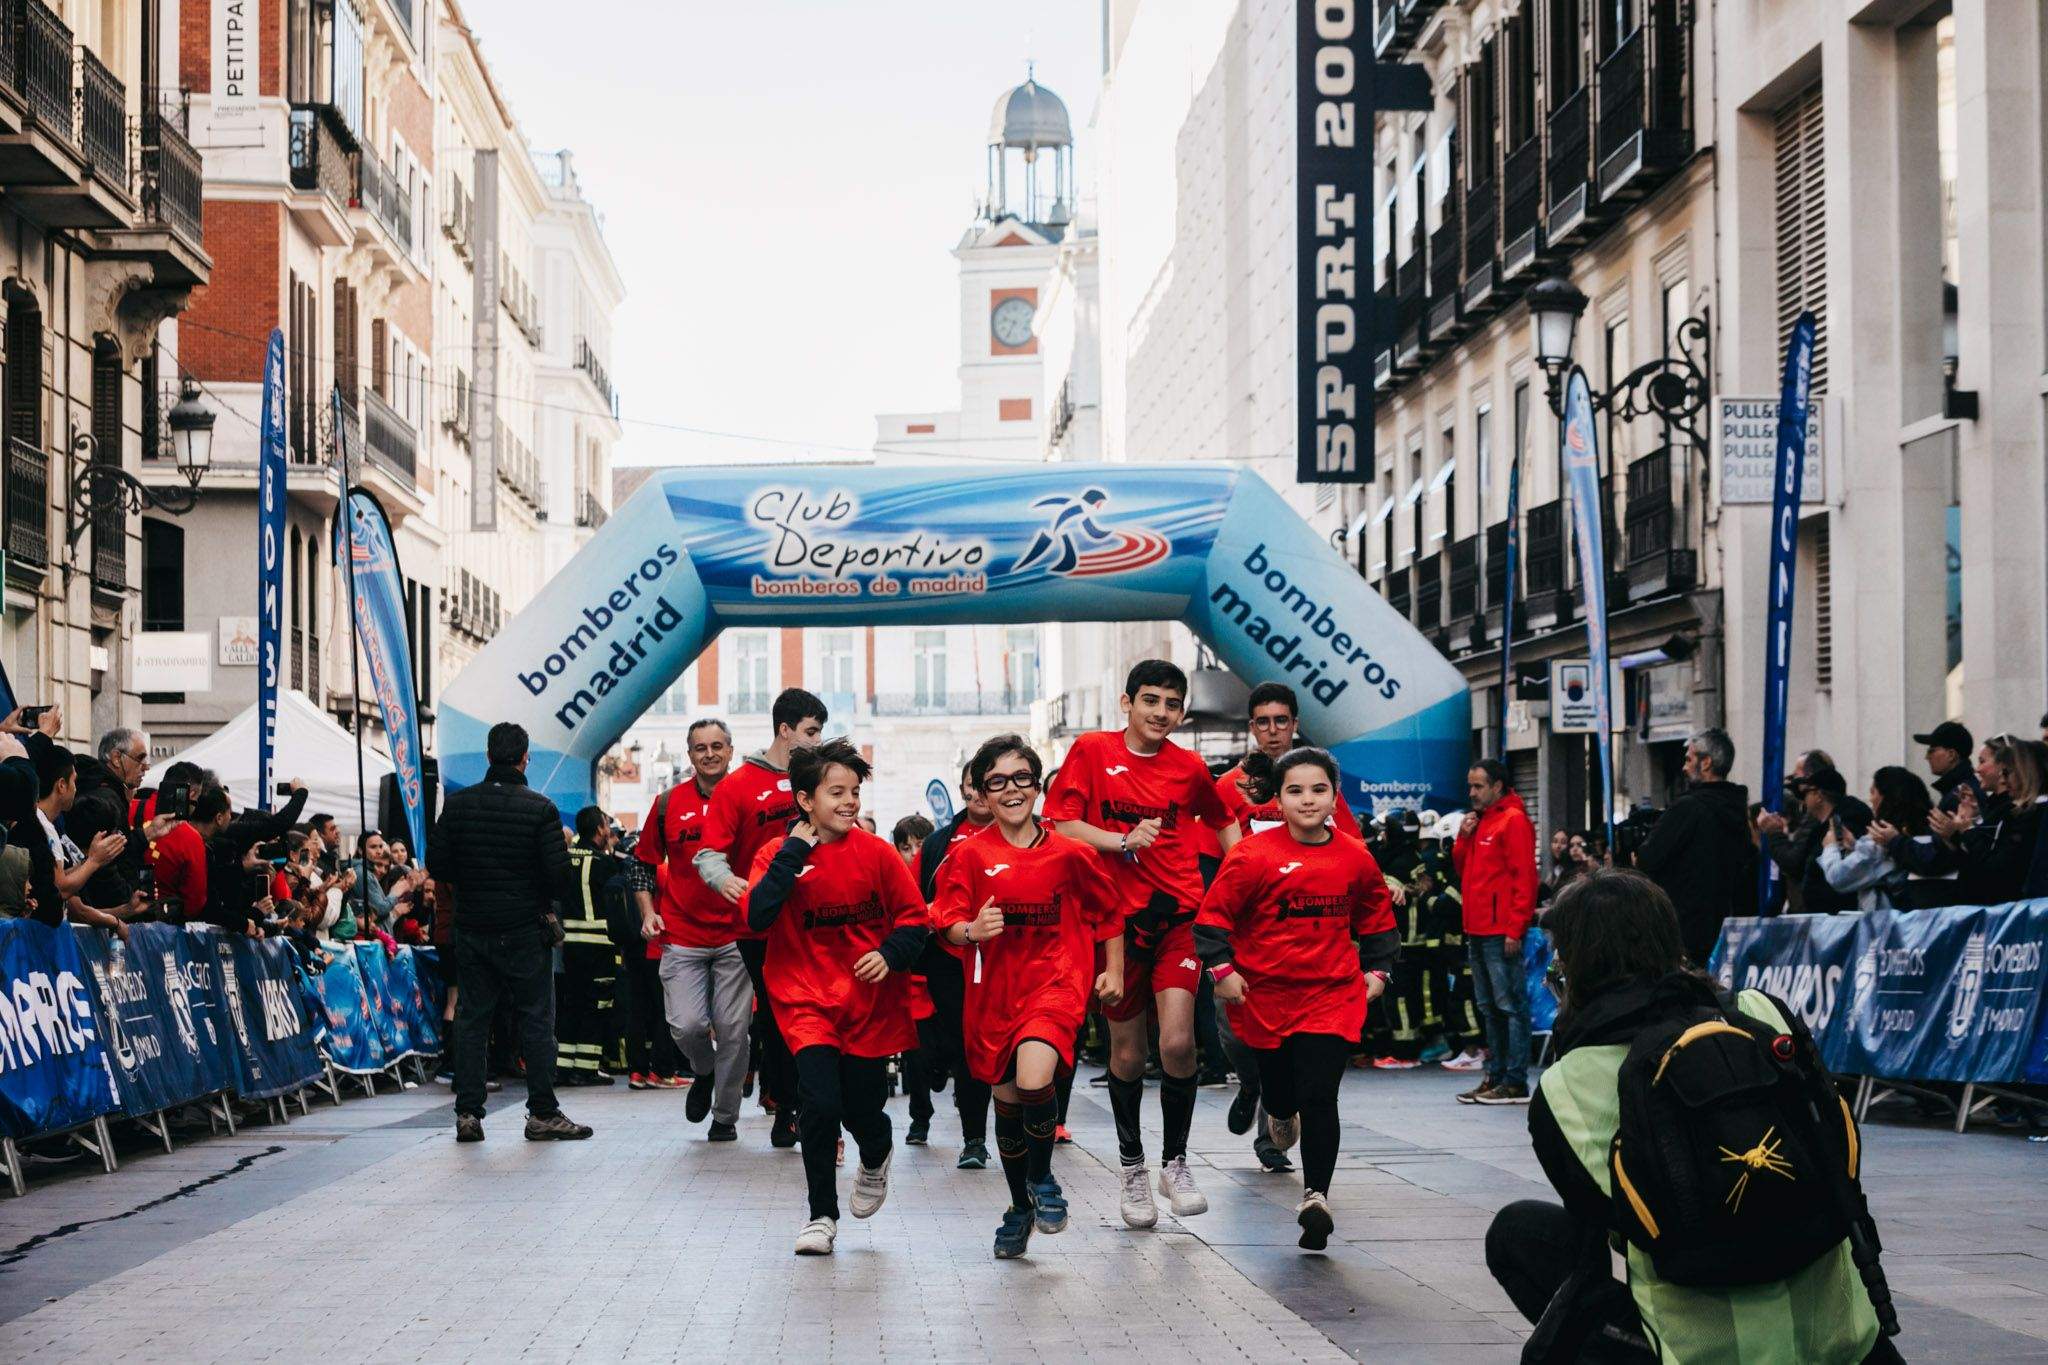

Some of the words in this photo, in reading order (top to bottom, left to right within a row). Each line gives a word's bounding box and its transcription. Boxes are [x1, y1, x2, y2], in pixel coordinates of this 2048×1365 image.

[1316, 184, 1356, 472] SPORT
[754, 491, 851, 523] Club
[774, 522, 984, 578] Deportivo
[518, 543, 678, 696] bomberos
[755, 577, 859, 595] bomberos
[870, 576, 898, 594] de
[911, 574, 985, 593] madrid
[1210, 582, 1349, 707] madrid
[1243, 543, 1401, 700] bomberos
[555, 596, 684, 730] madrid
[1360, 779, 1433, 793] bomberos
